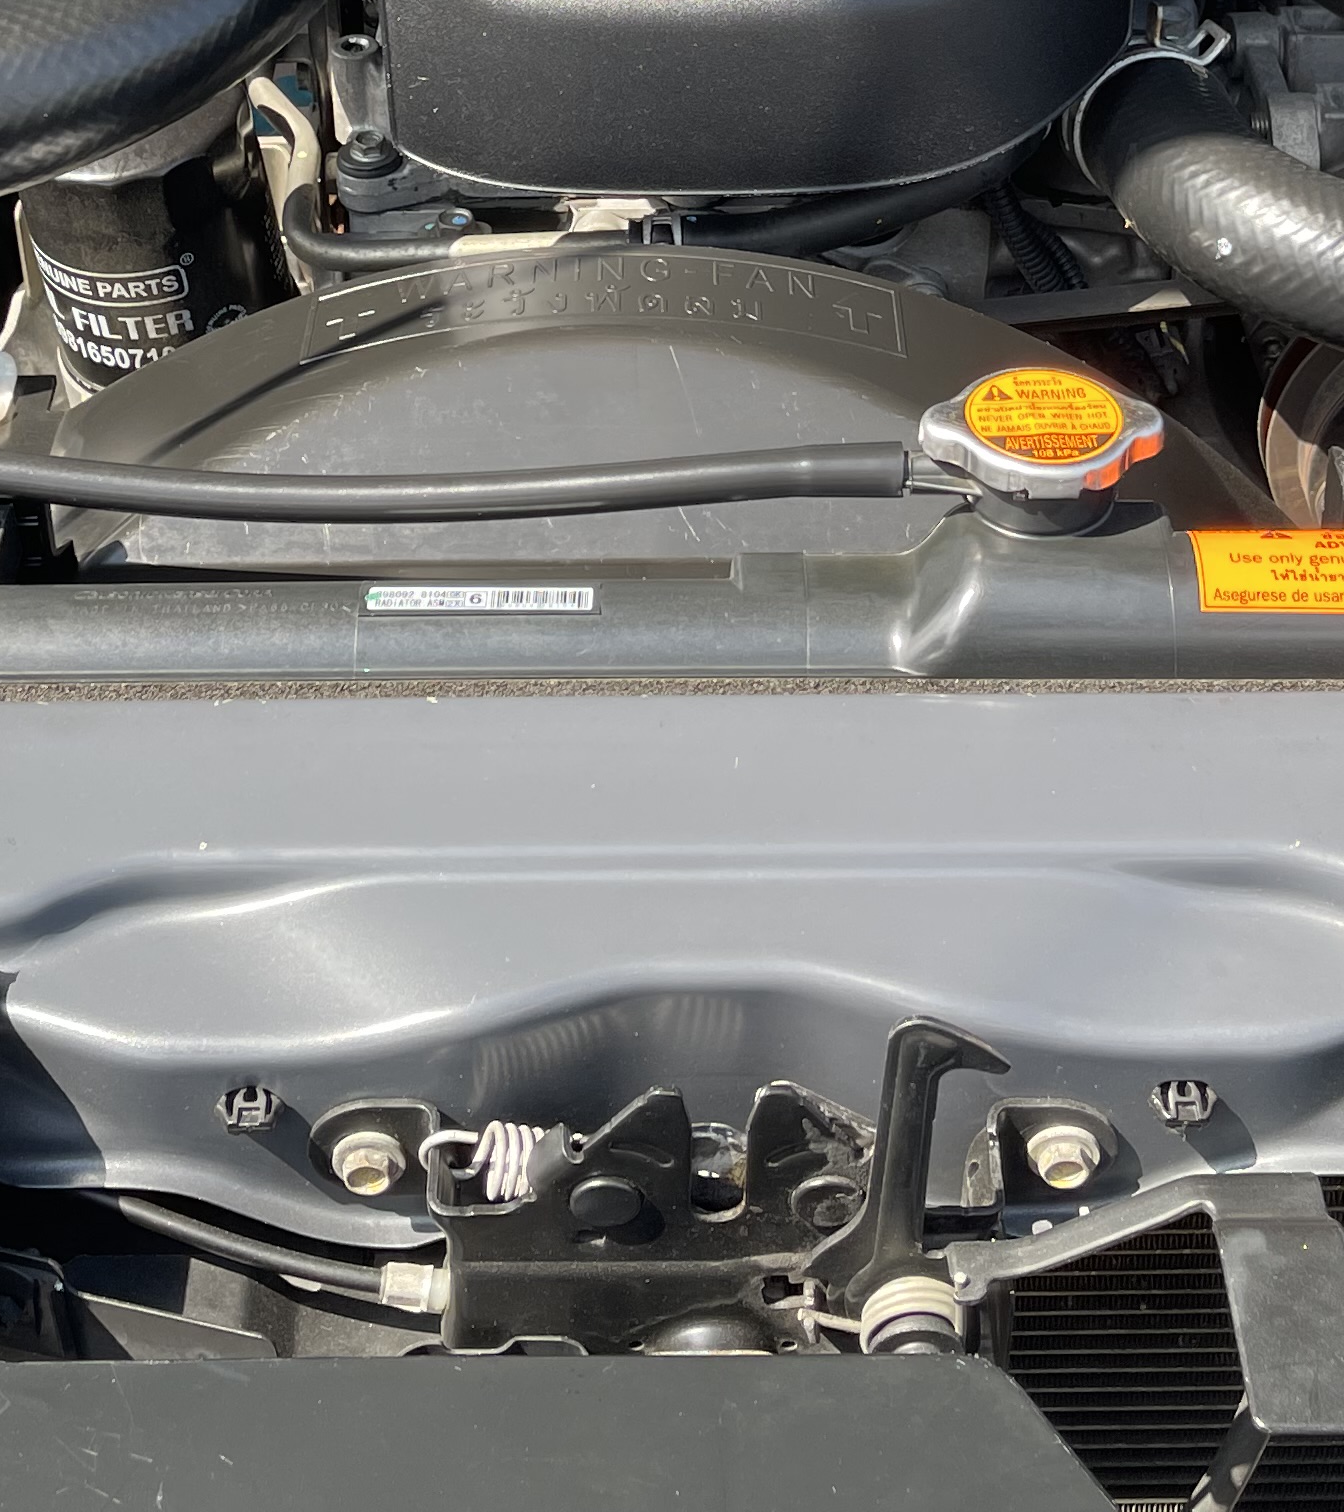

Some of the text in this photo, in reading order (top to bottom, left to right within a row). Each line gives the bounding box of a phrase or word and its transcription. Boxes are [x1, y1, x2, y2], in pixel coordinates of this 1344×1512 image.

[96, 275, 179, 299] PARTS
[71, 307, 194, 341] FILTER
[1015, 388, 1087, 400] WARNING
[978, 410, 1107, 423] NEVER OPEN WHEN HOT
[996, 423, 1032, 433] JAMAIS
[1034, 422, 1068, 432] OUVRIR
[1080, 421, 1111, 431] CHAUD
[1005, 434, 1098, 451] AVERTISSEMENT
[1056, 448, 1080, 457] kPa
[1229, 552, 1262, 564] Use
[1269, 552, 1303, 567] only
[375, 599, 421, 607] RADIATOR
[469, 593, 482, 605] 6
[1213, 588, 1287, 605] Asegurese
[1292, 589, 1309, 602] de
[1314, 592, 1344, 603] usar
